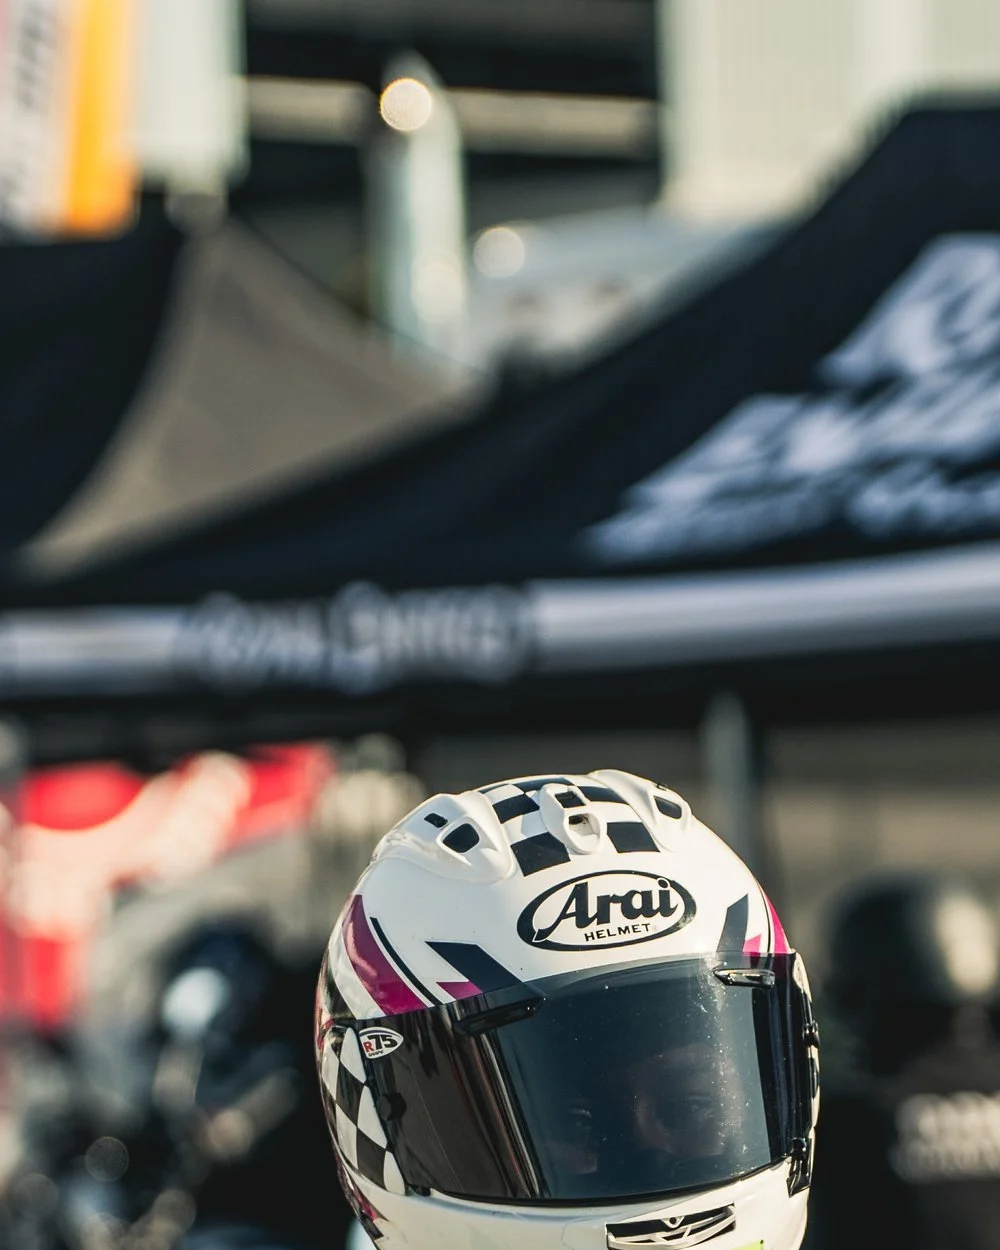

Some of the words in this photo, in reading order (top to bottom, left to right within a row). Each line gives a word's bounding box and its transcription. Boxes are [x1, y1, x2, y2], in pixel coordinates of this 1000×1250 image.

[534, 878, 679, 941] Arai
[585, 923, 650, 941] HELMET
[363, 1035, 398, 1053] R75
